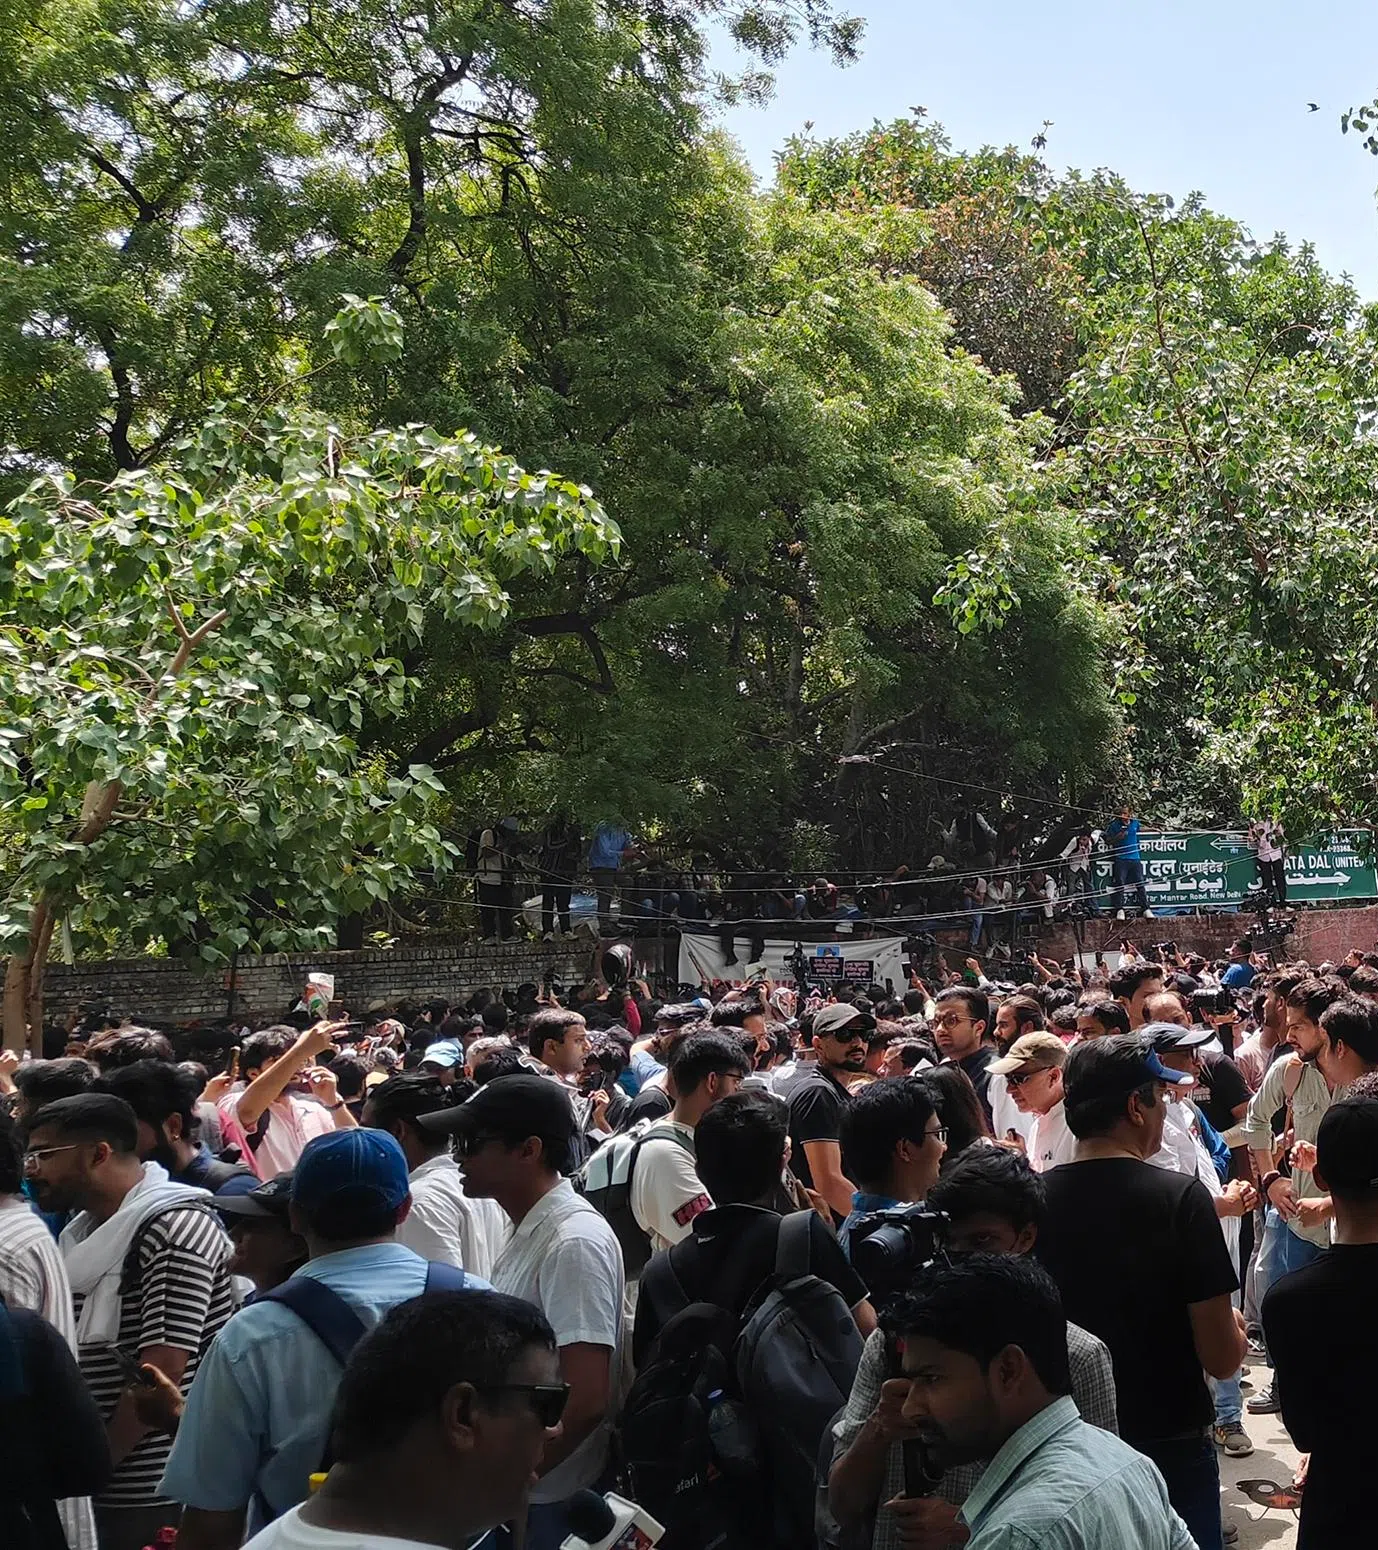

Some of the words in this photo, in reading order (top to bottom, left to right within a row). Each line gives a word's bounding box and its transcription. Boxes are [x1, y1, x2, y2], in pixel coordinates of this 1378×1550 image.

[1139, 835, 1188, 852] कार्यालय
[1150, 860, 1177, 877] दल
[1308, 854, 1331, 869] DAL
[1159, 894, 1188, 902] Mantar
[1210, 891, 1225, 899] New
